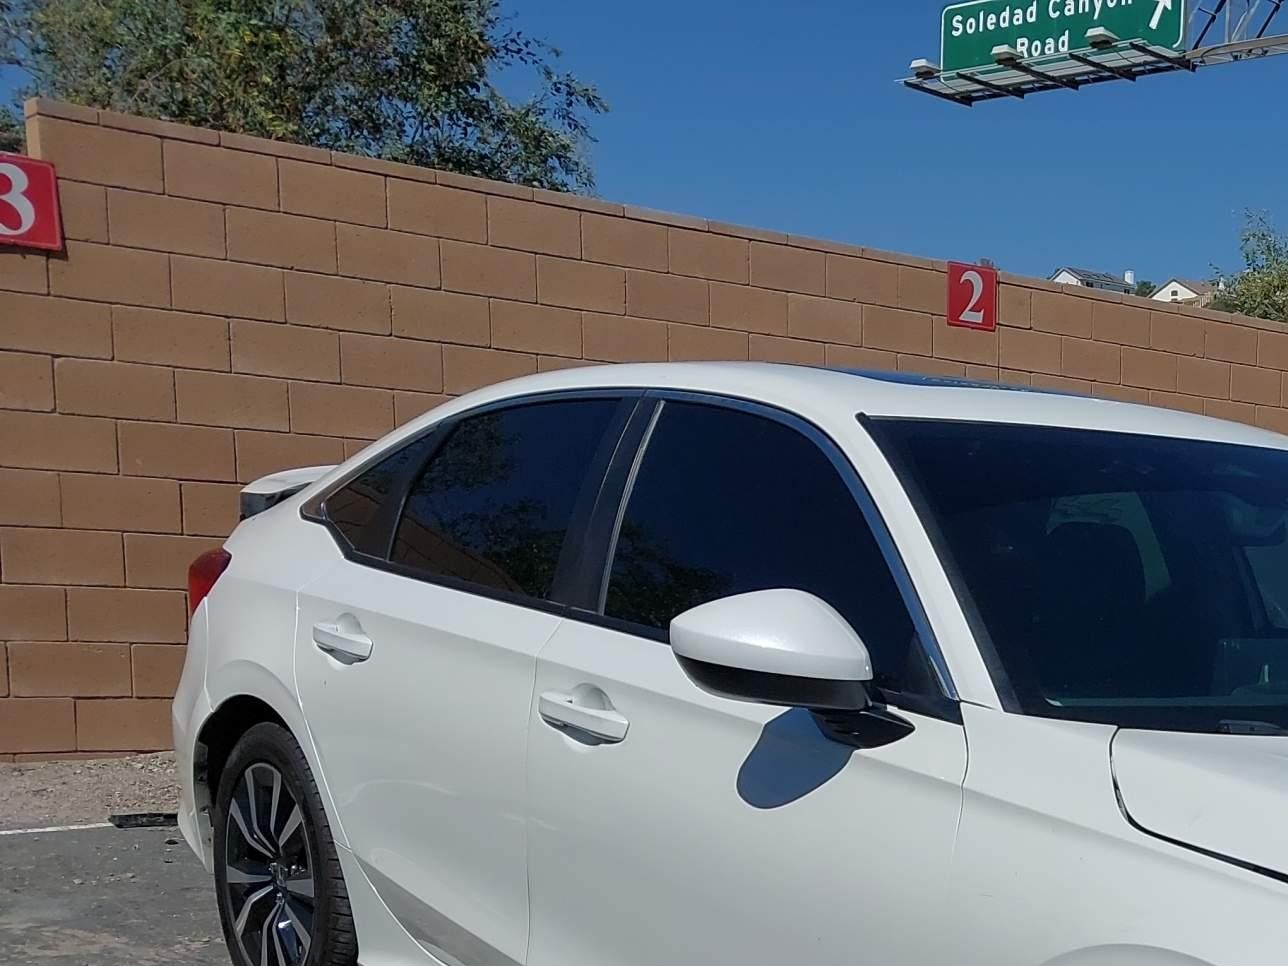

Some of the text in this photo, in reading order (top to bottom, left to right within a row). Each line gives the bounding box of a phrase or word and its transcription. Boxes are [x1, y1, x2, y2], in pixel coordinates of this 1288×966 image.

[951, 8, 1037, 37] Soledad
[1016, 29, 1069, 58] Road
[0, 162, 36, 236] 3
[958, 270, 985, 324] 2
